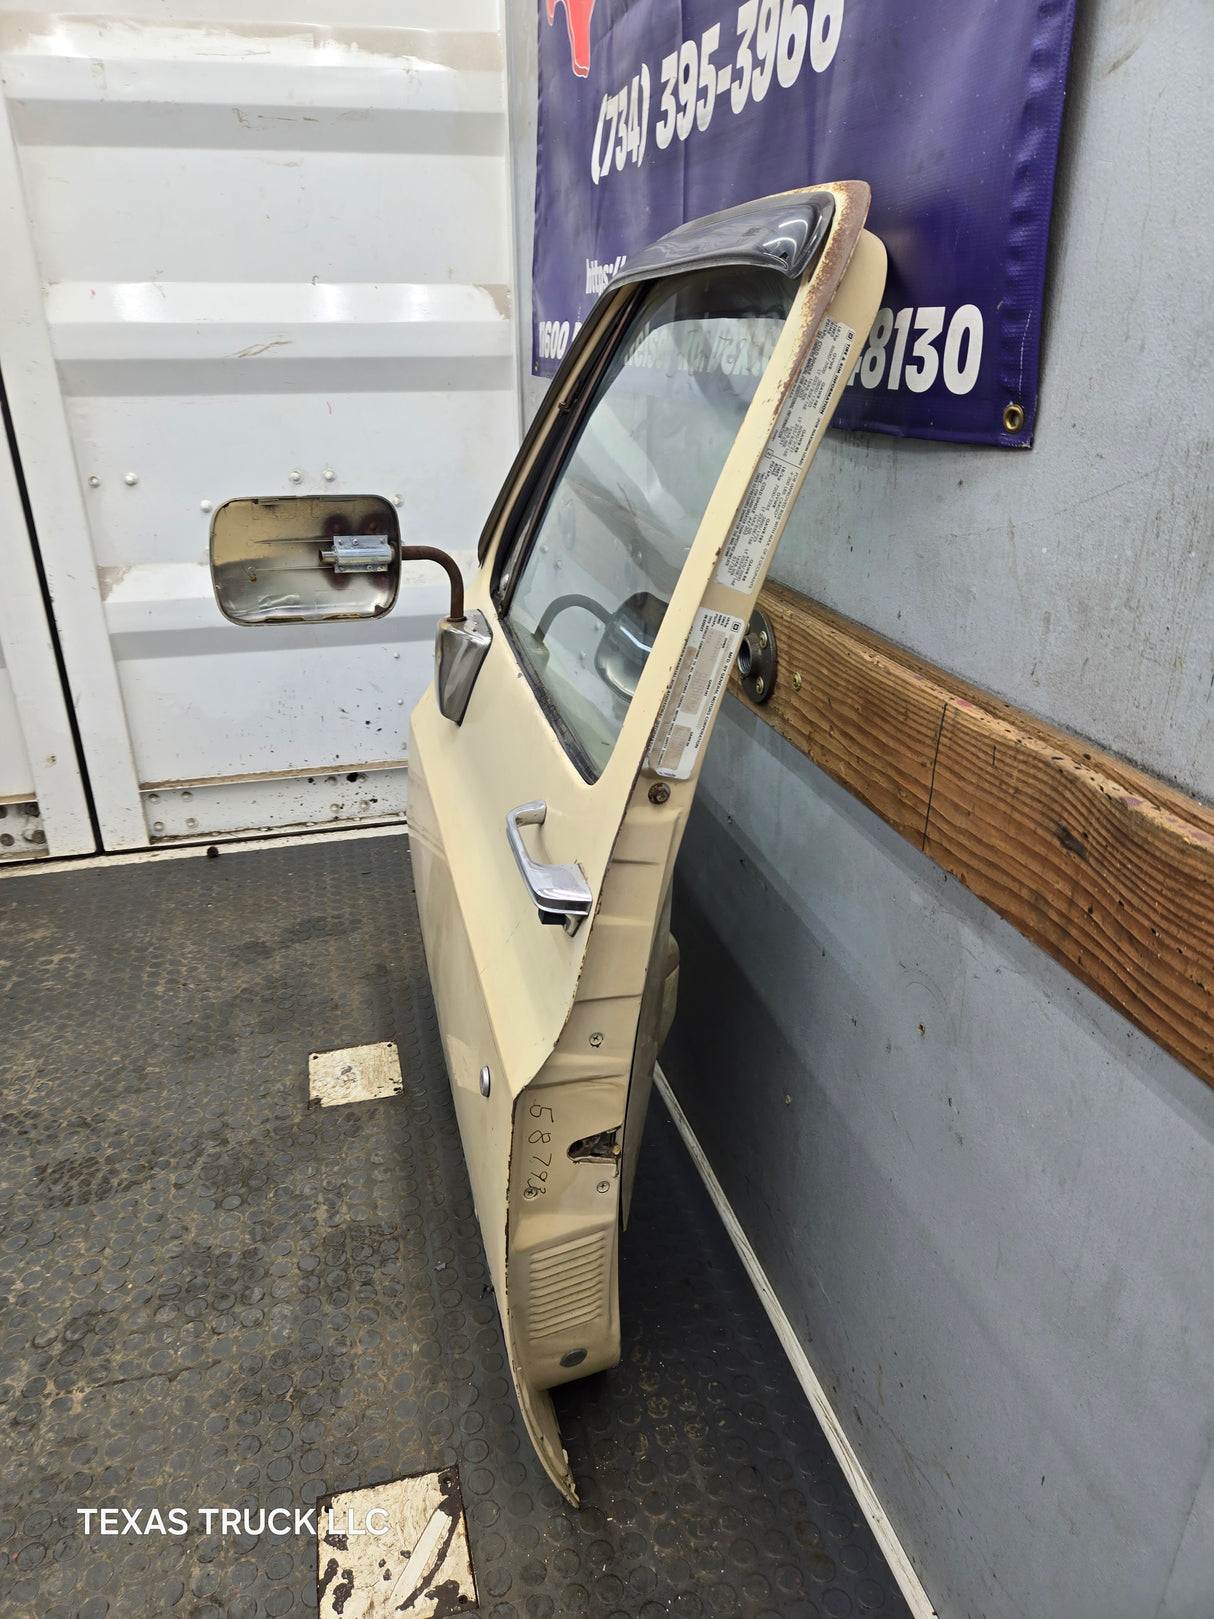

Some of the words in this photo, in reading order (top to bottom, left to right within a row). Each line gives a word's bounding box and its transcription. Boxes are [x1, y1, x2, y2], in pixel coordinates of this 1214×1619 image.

[591, 62, 651, 185] (734)
[846, 304, 984, 395] 8130
[819, 374, 838, 414] INFORMATION
[713, 672, 725, 695] GENERAL
[706, 695, 716, 715] MOTORS
[694, 716, 709, 748] CORPORATION
